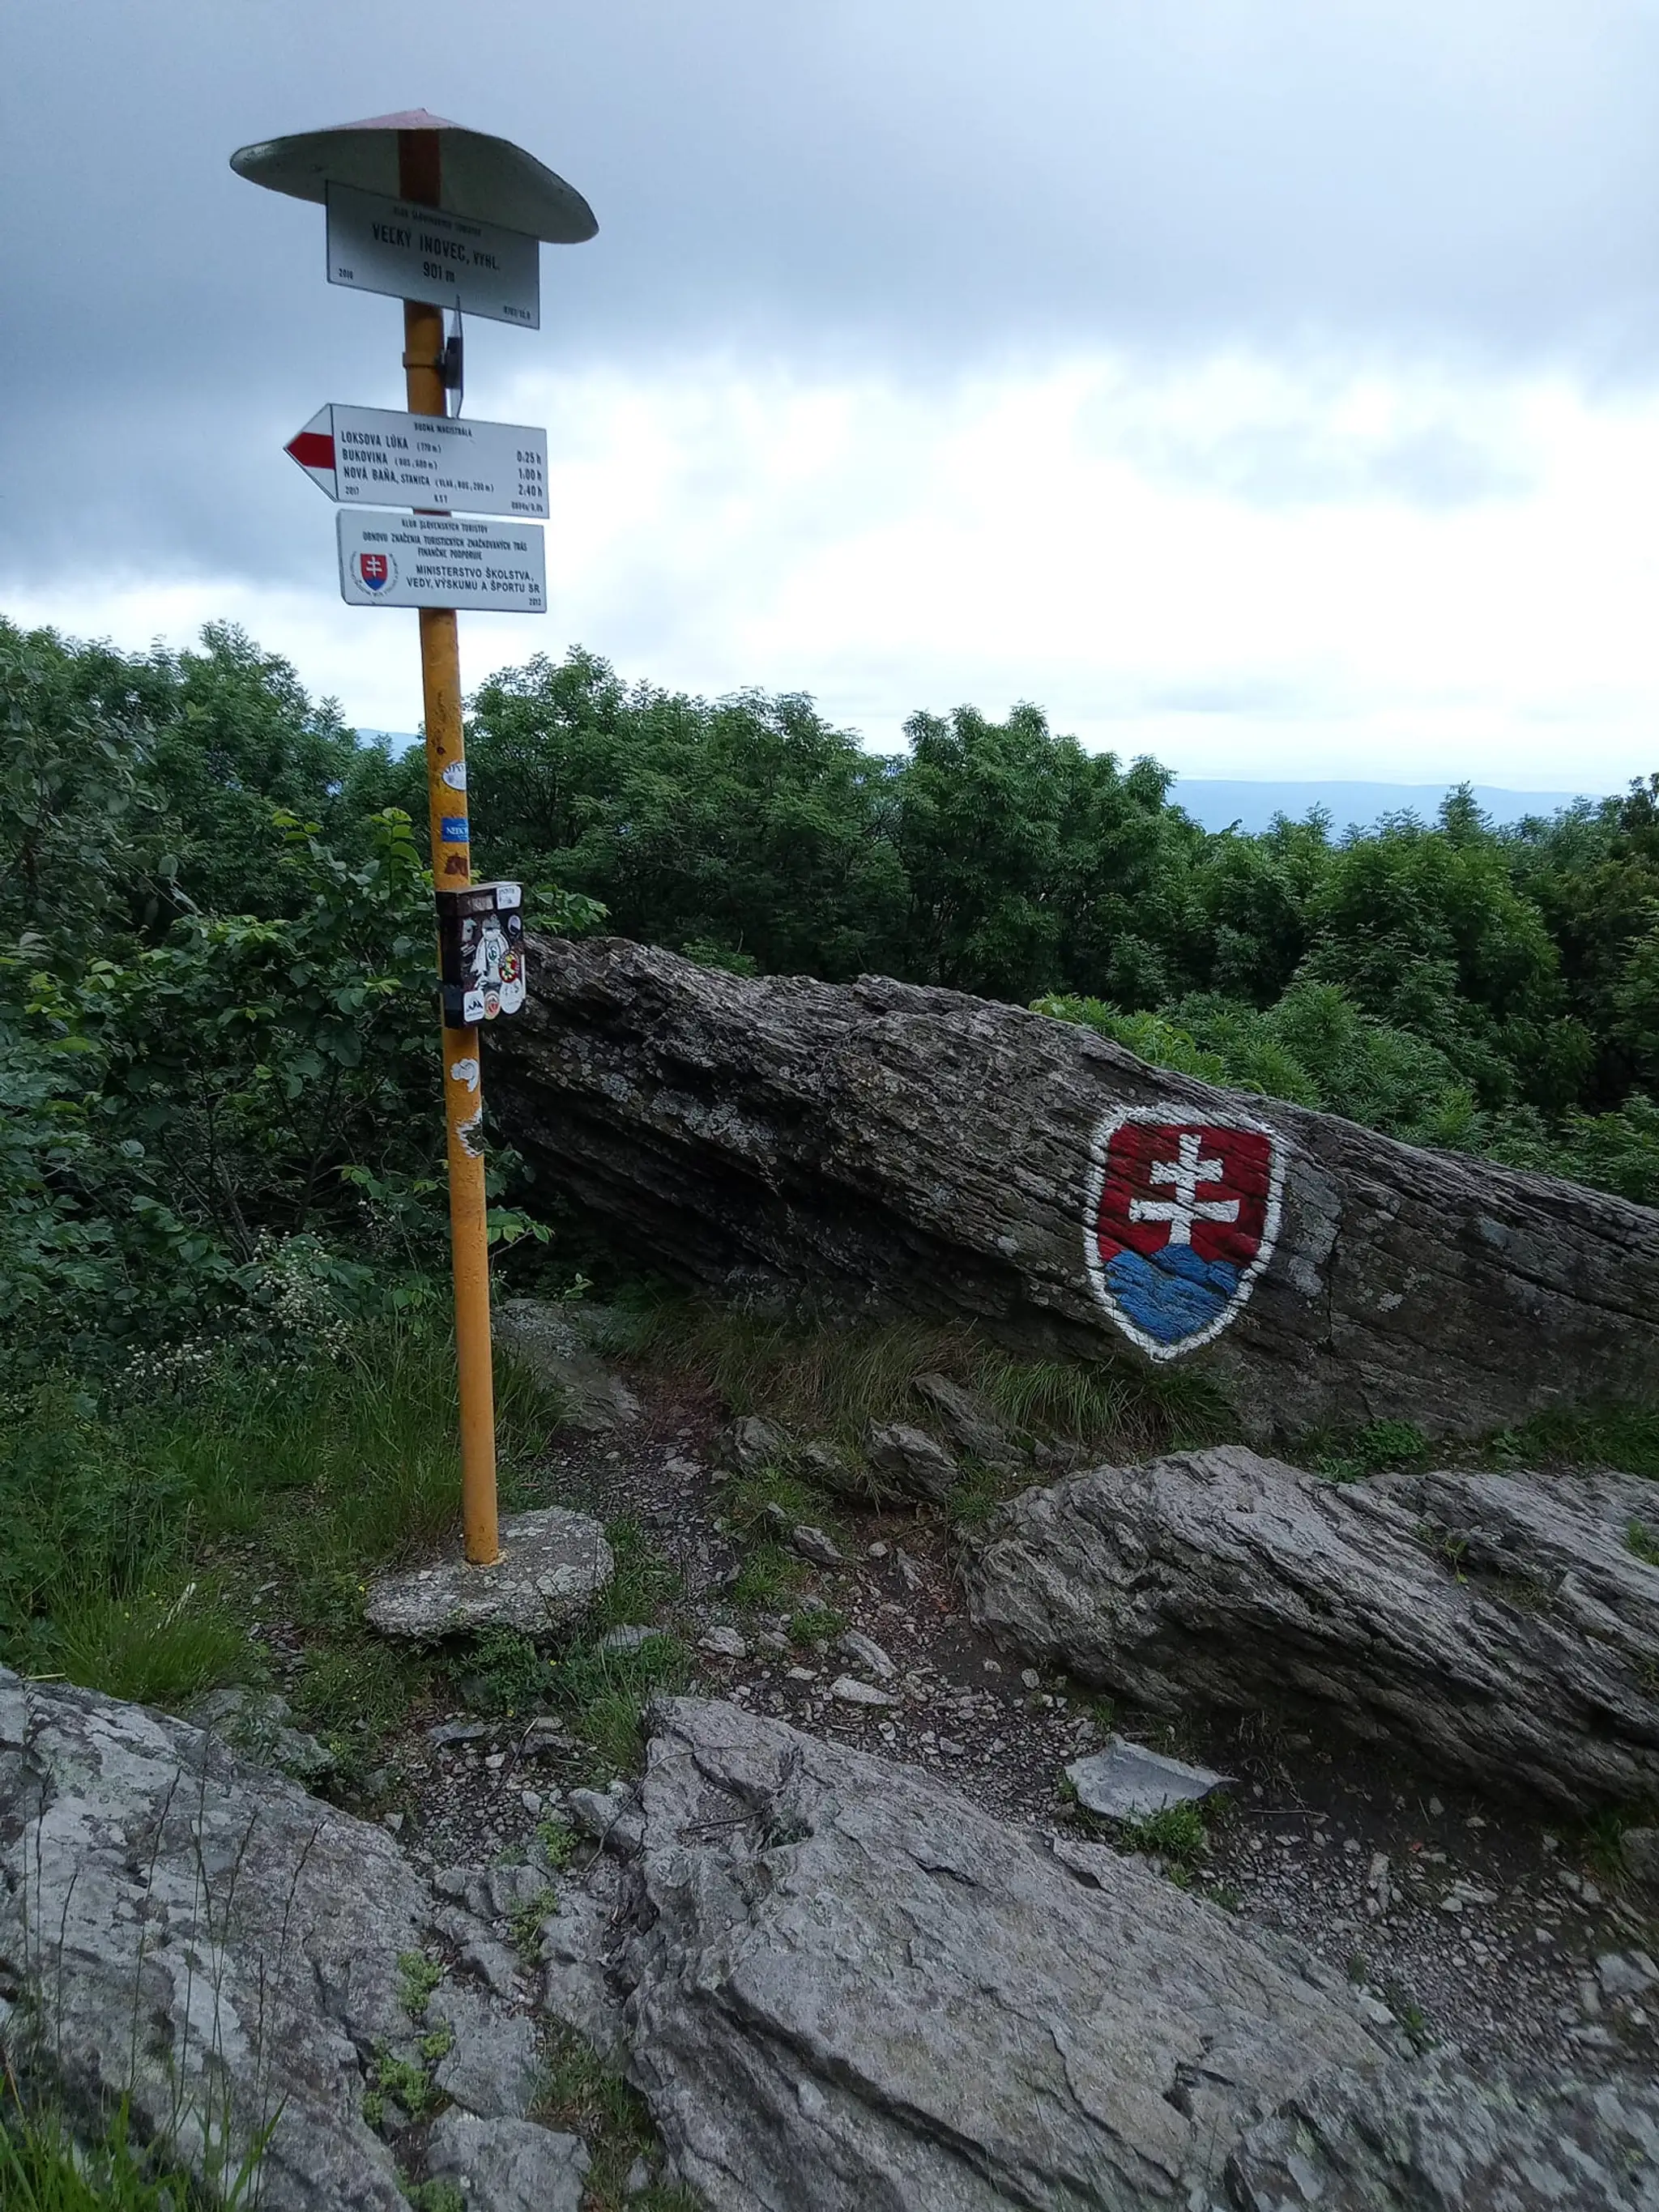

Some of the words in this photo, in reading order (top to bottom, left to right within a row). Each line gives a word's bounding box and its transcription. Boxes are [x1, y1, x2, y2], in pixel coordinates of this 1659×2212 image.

[420, 233, 470, 266] INOVEC,
[423, 262, 442, 280] 901
[446, 270, 455, 283] m
[385, 433, 409, 450] LÚKA
[342, 448, 389, 465] BUKOVINA
[535, 451, 542, 466] h
[400, 473, 431, 486] STANICA
[536, 469, 543, 484] h
[536, 485, 543, 498] h
[416, 565, 482, 579] MINISTERSTVO
[486, 565, 535, 582] ŠKOLSTVA,
[406, 576, 433, 589] VEDY,
[434, 577, 478, 590] VÝSKUMU
[481, 581, 488, 592] A
[490, 579, 526, 594] ŠPORTU
[528, 582, 540, 595] SR
